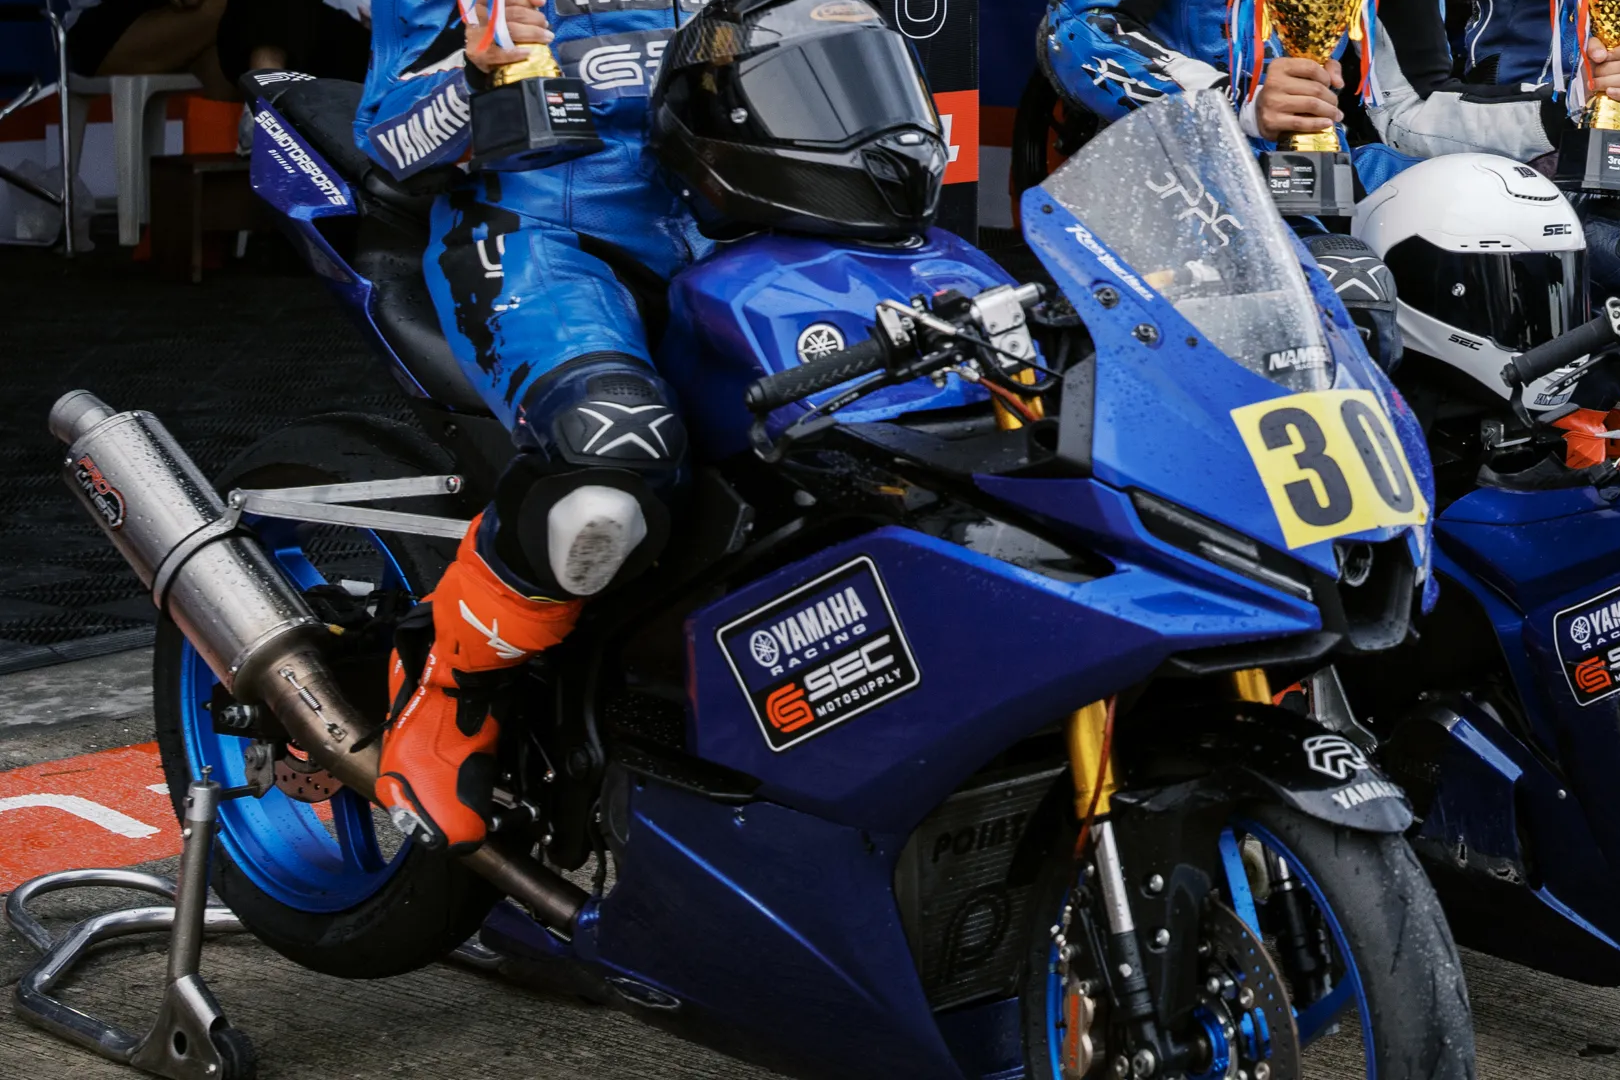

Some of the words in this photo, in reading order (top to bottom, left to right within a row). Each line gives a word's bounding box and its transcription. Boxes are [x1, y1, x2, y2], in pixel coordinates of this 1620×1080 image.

[377, 84, 471, 170] YAMAHA
[254, 110, 348, 207] SECMOTORSPORTS
[1270, 179, 1290, 188] 3rd
[1543, 224, 1572, 236] SEC
[1447, 333, 1484, 352] SEC
[77, 455, 112, 496] PRO
[1258, 399, 1416, 527] 30
[75, 469, 121, 527] LINER
[770, 586, 868, 655] YAMAHA
[770, 623, 867, 677] RACING
[803, 634, 895, 703] SEC
[815, 667, 902, 718] MOTOSUPPLY
